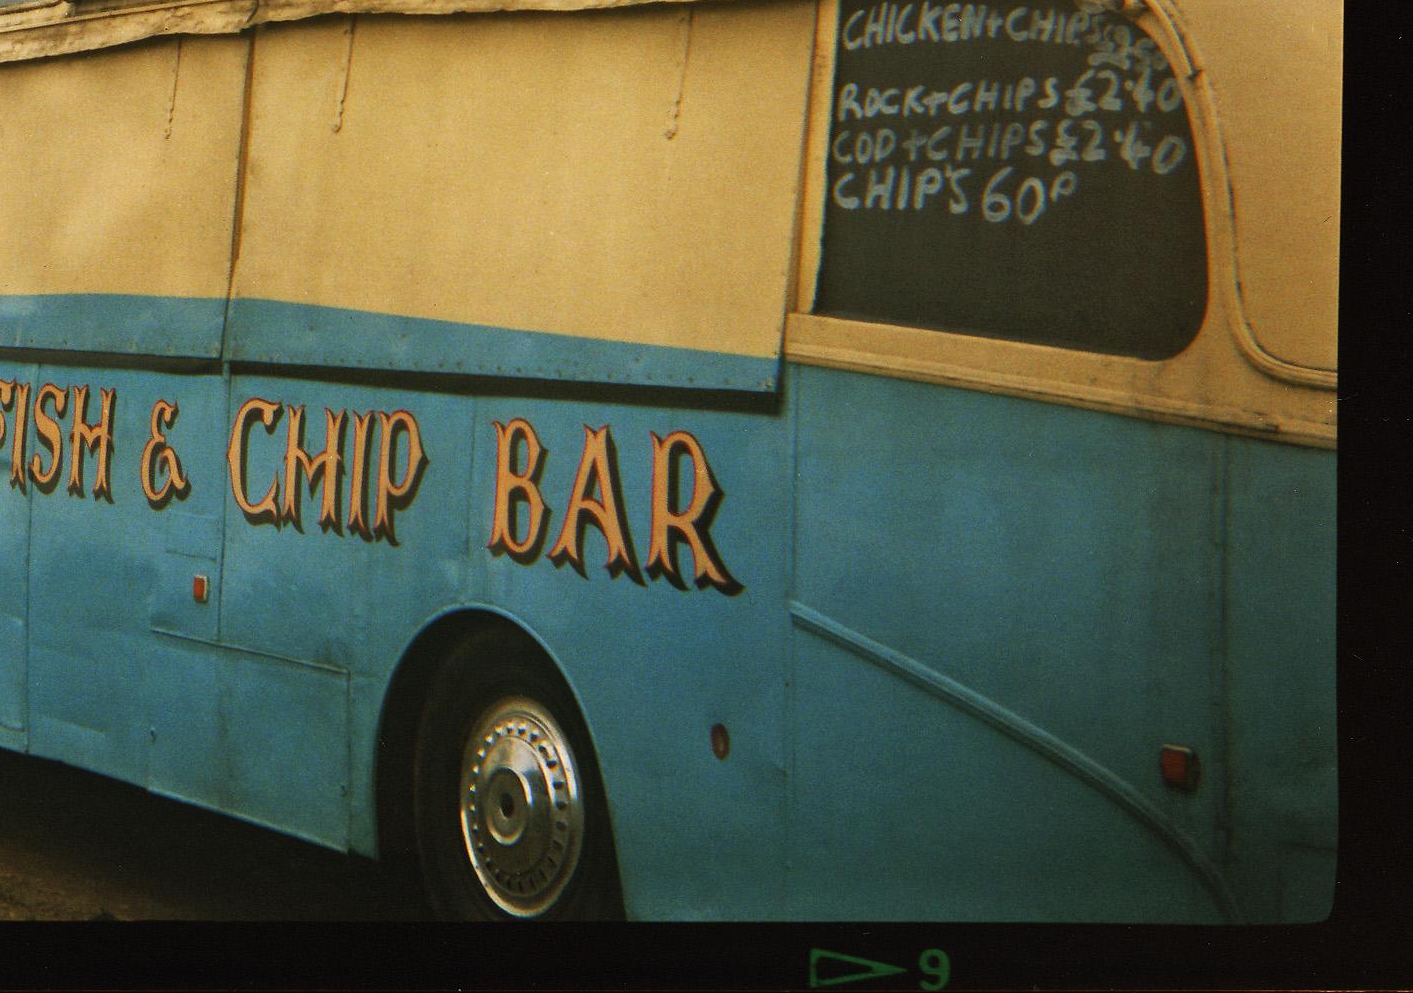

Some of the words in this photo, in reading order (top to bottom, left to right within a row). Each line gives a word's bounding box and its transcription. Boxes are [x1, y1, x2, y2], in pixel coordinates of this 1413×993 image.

[140, 399, 192, 511] &
[227, 397, 430, 547] CHIP
[488, 417, 746, 597] BAR
[919, 947, 950, 991] 9
